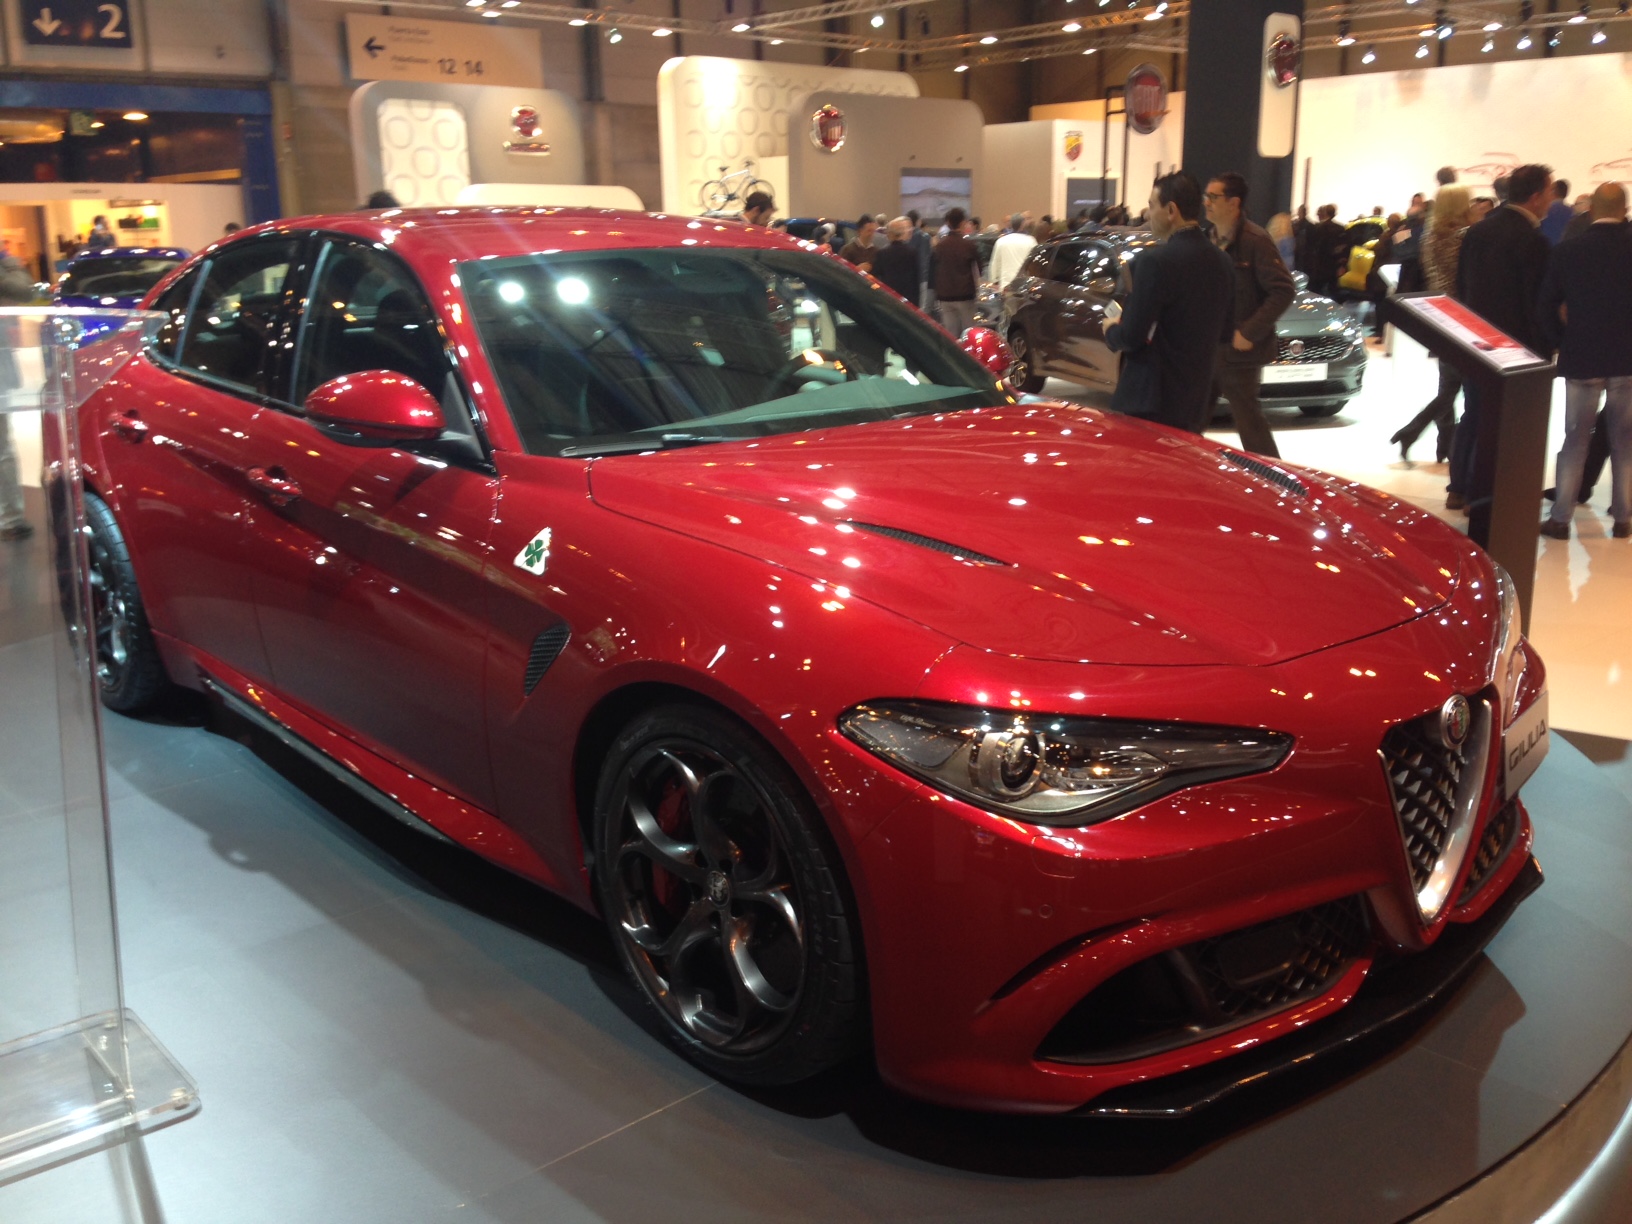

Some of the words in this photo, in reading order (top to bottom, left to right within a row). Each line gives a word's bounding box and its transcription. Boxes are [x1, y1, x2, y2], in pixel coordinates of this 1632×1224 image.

[97, 3, 126, 38] 2
[438, 58, 457, 75] 12
[464, 60, 484, 76] 14
[1509, 719, 1546, 771] GIULIA
